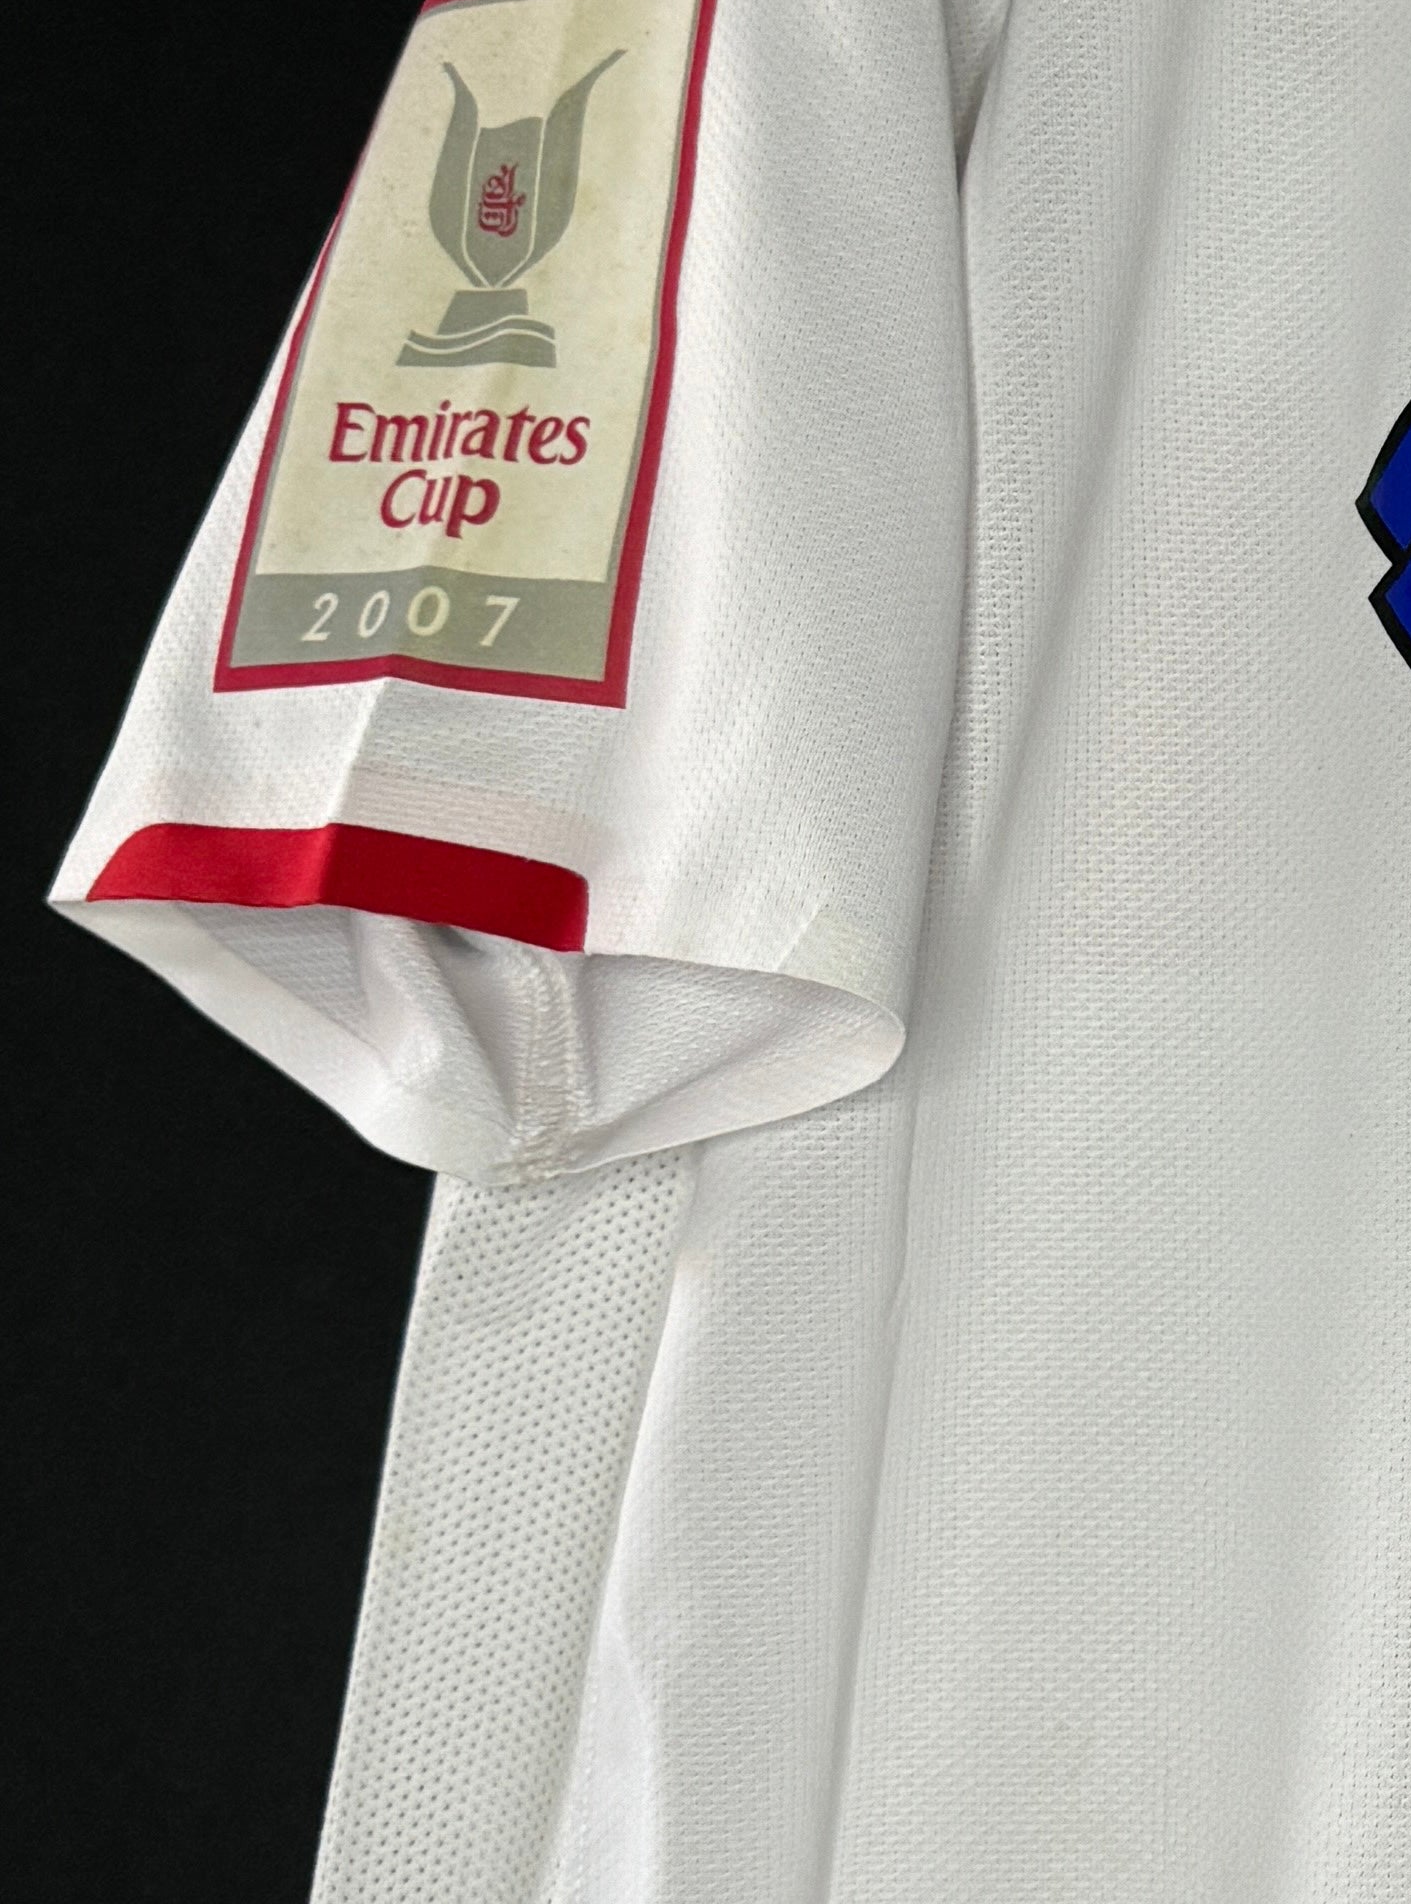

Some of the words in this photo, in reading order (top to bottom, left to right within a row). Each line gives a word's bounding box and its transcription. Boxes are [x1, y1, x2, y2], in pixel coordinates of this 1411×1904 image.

[329, 400, 589, 466] Emirates
[380, 469, 500, 538] Cup
[301, 585, 521, 647] 2007
